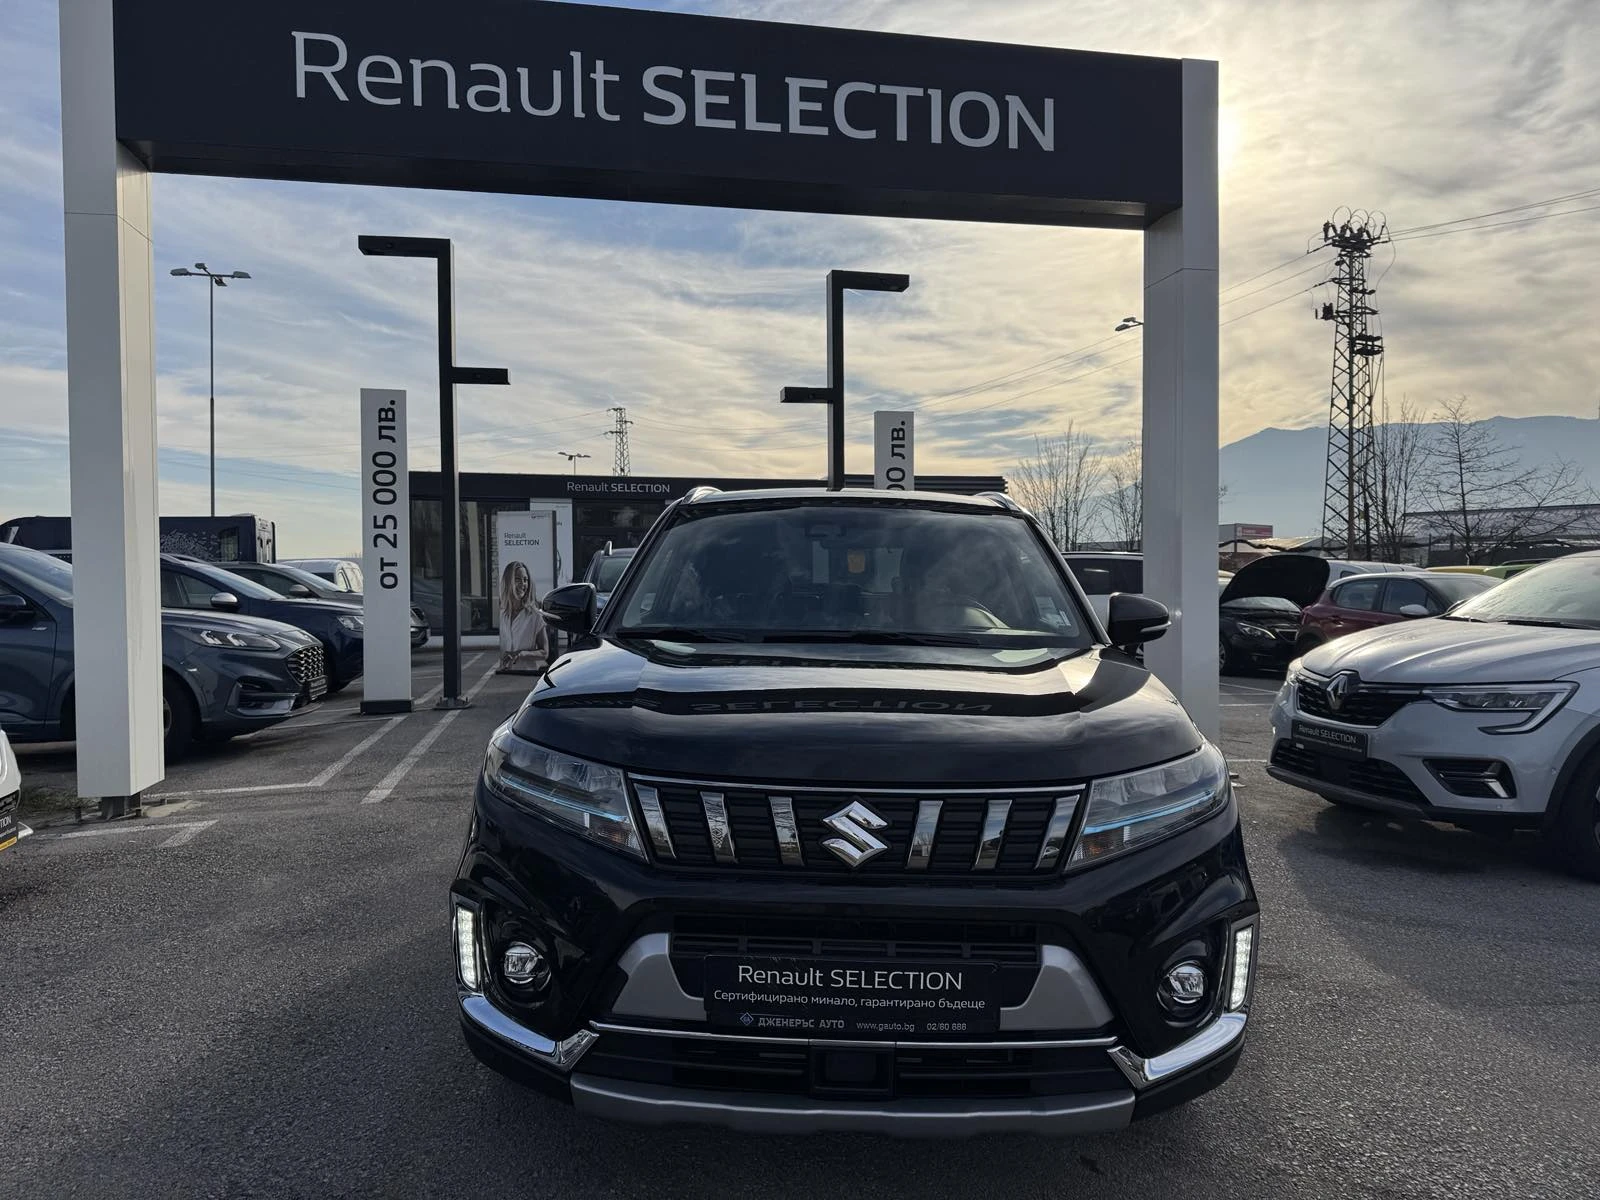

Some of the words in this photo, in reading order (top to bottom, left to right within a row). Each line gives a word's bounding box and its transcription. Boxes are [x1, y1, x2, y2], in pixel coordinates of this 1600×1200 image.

[291, 30, 621, 122] Renault
[642, 64, 1056, 152] SELECTION
[371, 451, 398, 506] 000
[567, 481, 609, 493] Renault
[610, 483, 671, 493] SELECTION
[373, 514, 398, 549] 25
[504, 532, 527, 540] Renault
[504, 539, 540, 547] SELECTION
[1320, 728, 1357, 744] SELECTION
[738, 965, 824, 988] Renault
[830, 969, 963, 991] SELECTION
[713, 989, 808, 1005] Сертифицирано
[811, 995, 858, 1007] минало,
[860, 997, 936, 1010] гарантирано
[938, 998, 986, 1010] бъдеще
[818, 1018, 846, 1029] АУТО
[856, 1022, 916, 1033] www.gauto.bg
